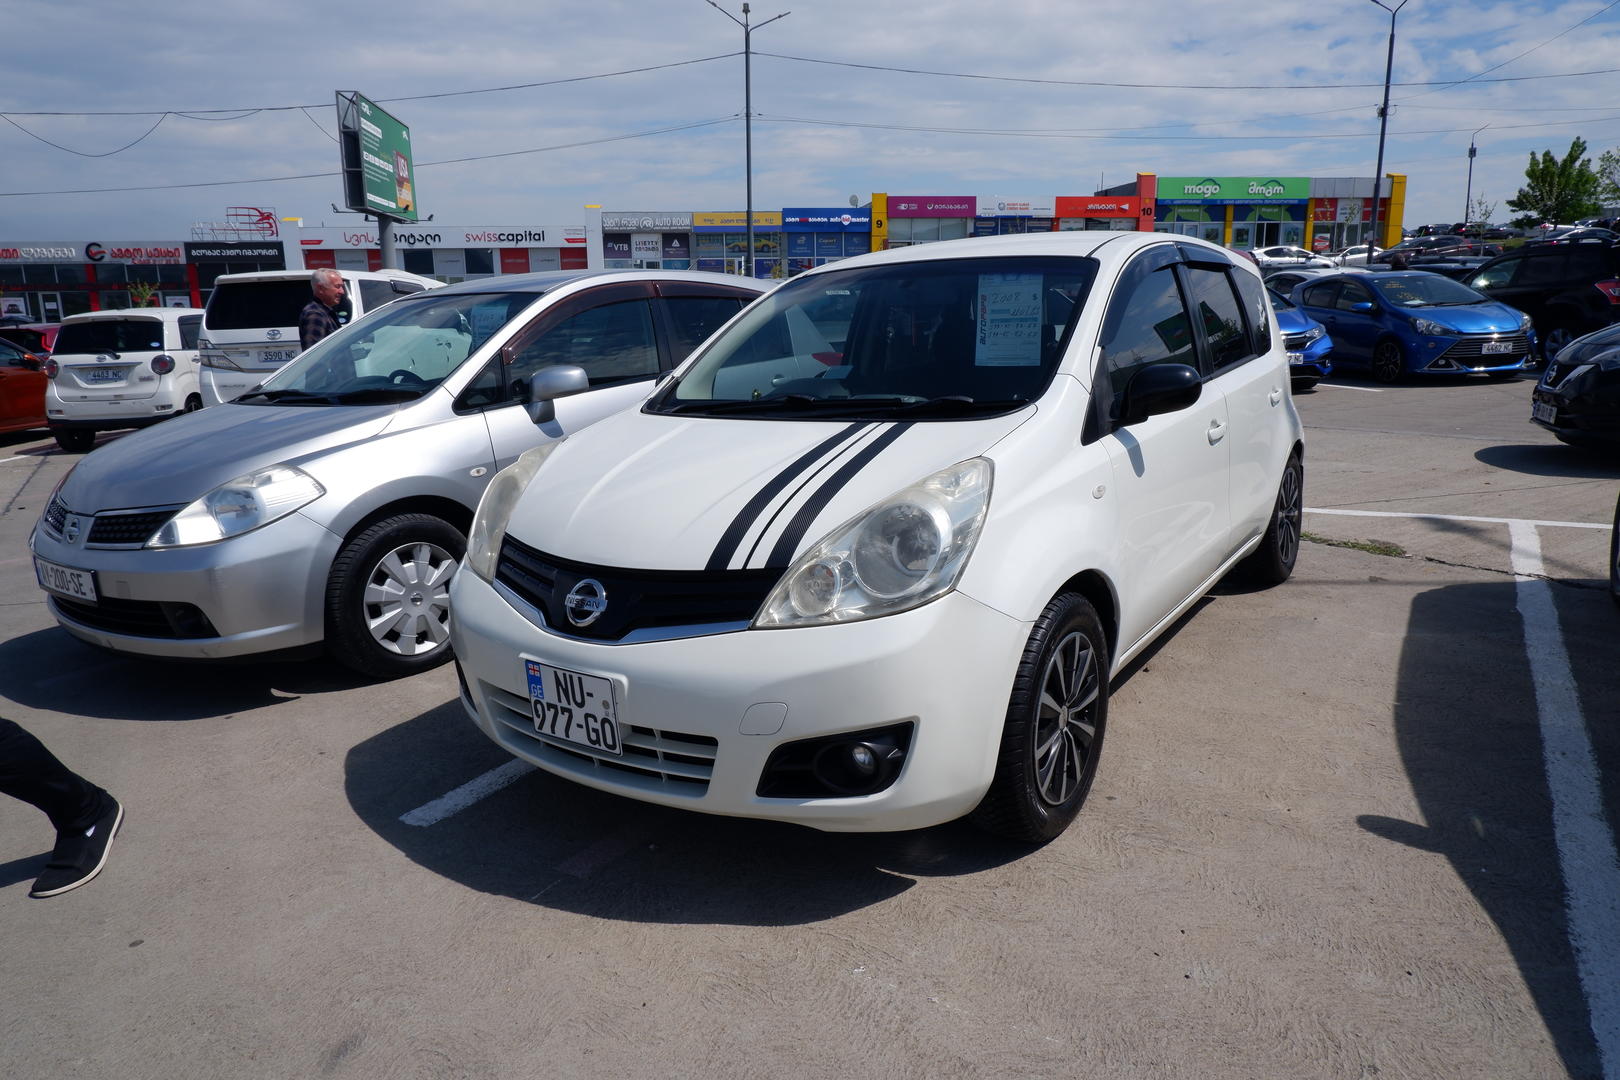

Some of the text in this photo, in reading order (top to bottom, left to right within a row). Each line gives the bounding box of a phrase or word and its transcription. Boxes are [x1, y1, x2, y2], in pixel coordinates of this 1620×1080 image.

[1184, 185, 1220, 198] mogo
[1249, 181, 1284, 197] მოგო
[1141, 207, 1153, 216] 10
[655, 217, 690, 226] AUTO ROOM
[876, 219, 884, 229] 9
[464, 230, 546, 247] swisscapital
[614, 243, 629, 251] VTB
[263, 351, 283, 361] 3590
[531, 684, 544, 698] GE
[553, 670, 595, 709] NU-
[533, 699, 617, 751] 977-GO
